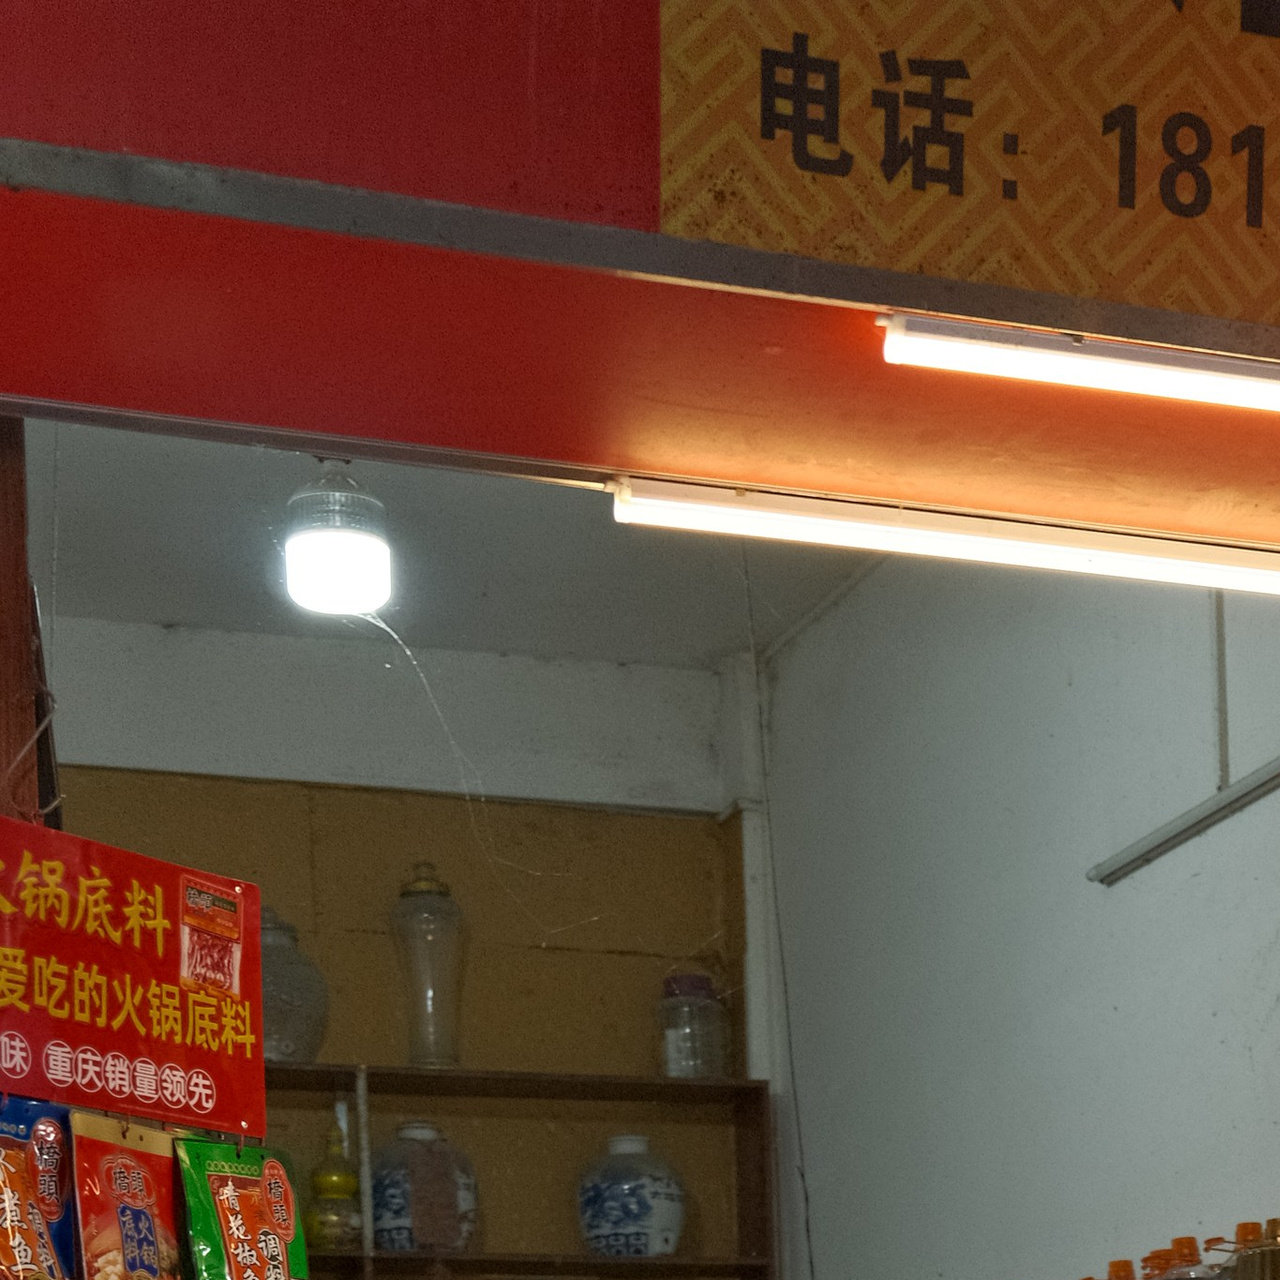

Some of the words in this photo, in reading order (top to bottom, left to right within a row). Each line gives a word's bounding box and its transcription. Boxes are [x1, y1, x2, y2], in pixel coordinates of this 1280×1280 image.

[46, 1045, 214, 1109] 重庆销量领先
[36, 1139, 62, 1204] 橋頭
[112, 1167, 147, 1199] 橋頭
[267, 1178, 291, 1226] 橋頭
